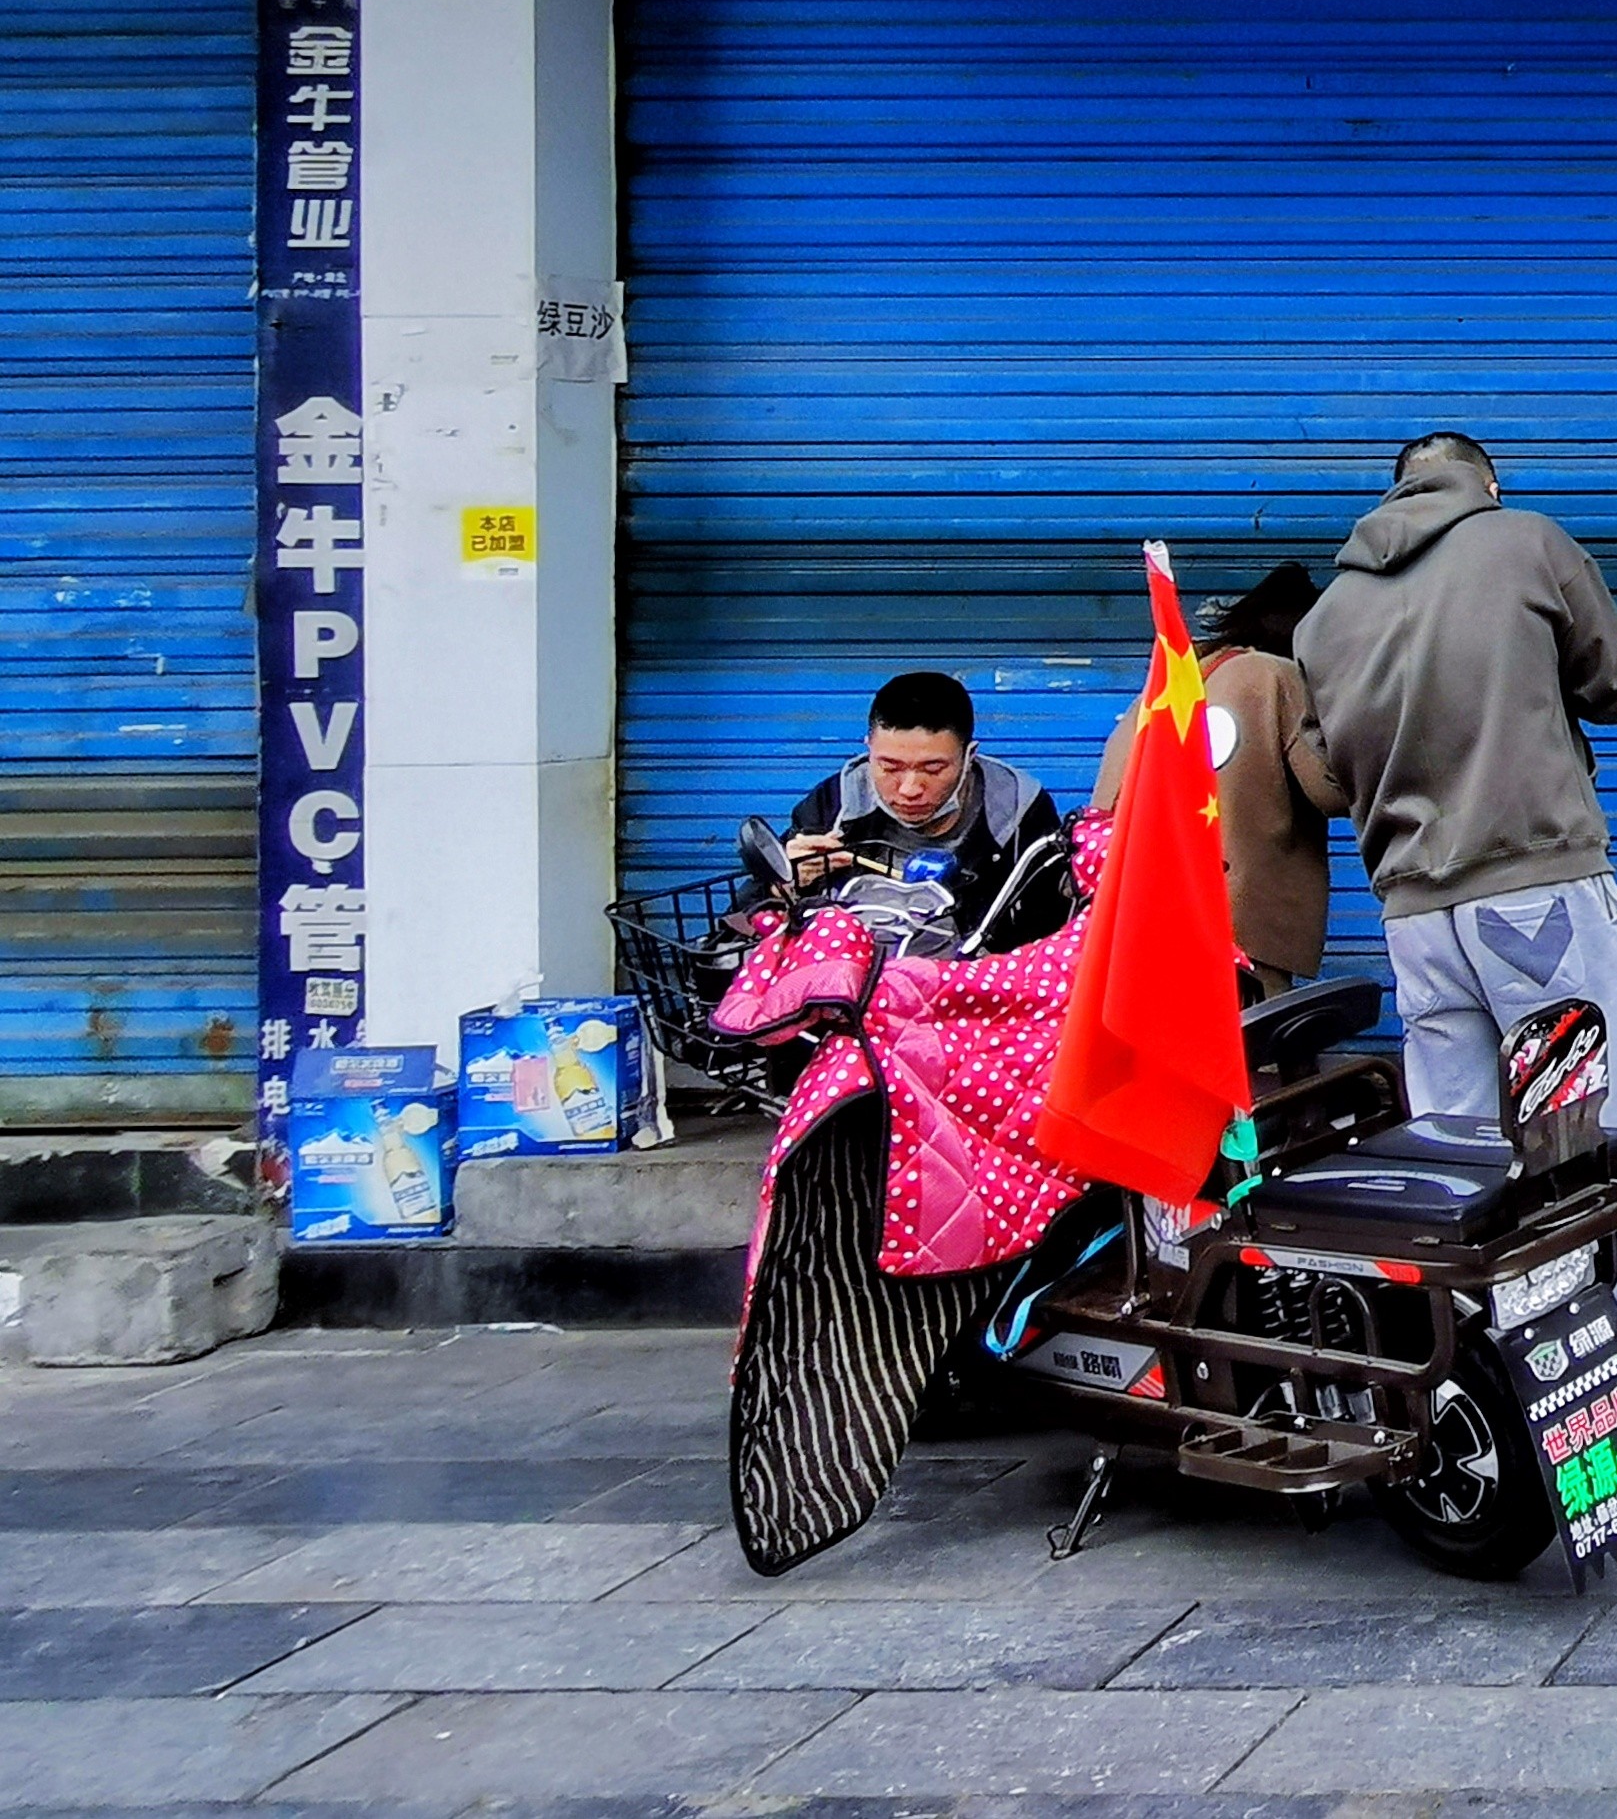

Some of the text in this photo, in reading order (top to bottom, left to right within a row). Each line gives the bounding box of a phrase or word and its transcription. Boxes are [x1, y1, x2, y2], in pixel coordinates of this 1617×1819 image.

[286, 25, 354, 248] 金牛管业
[537, 299, 616, 340] 绿豆沙
[479, 515, 516, 532] 本店
[274, 395, 367, 972] 金牛PVC管
[1296, 1256, 1365, 1273] FASHION
[1568, 1314, 1616, 1360] 绿源
